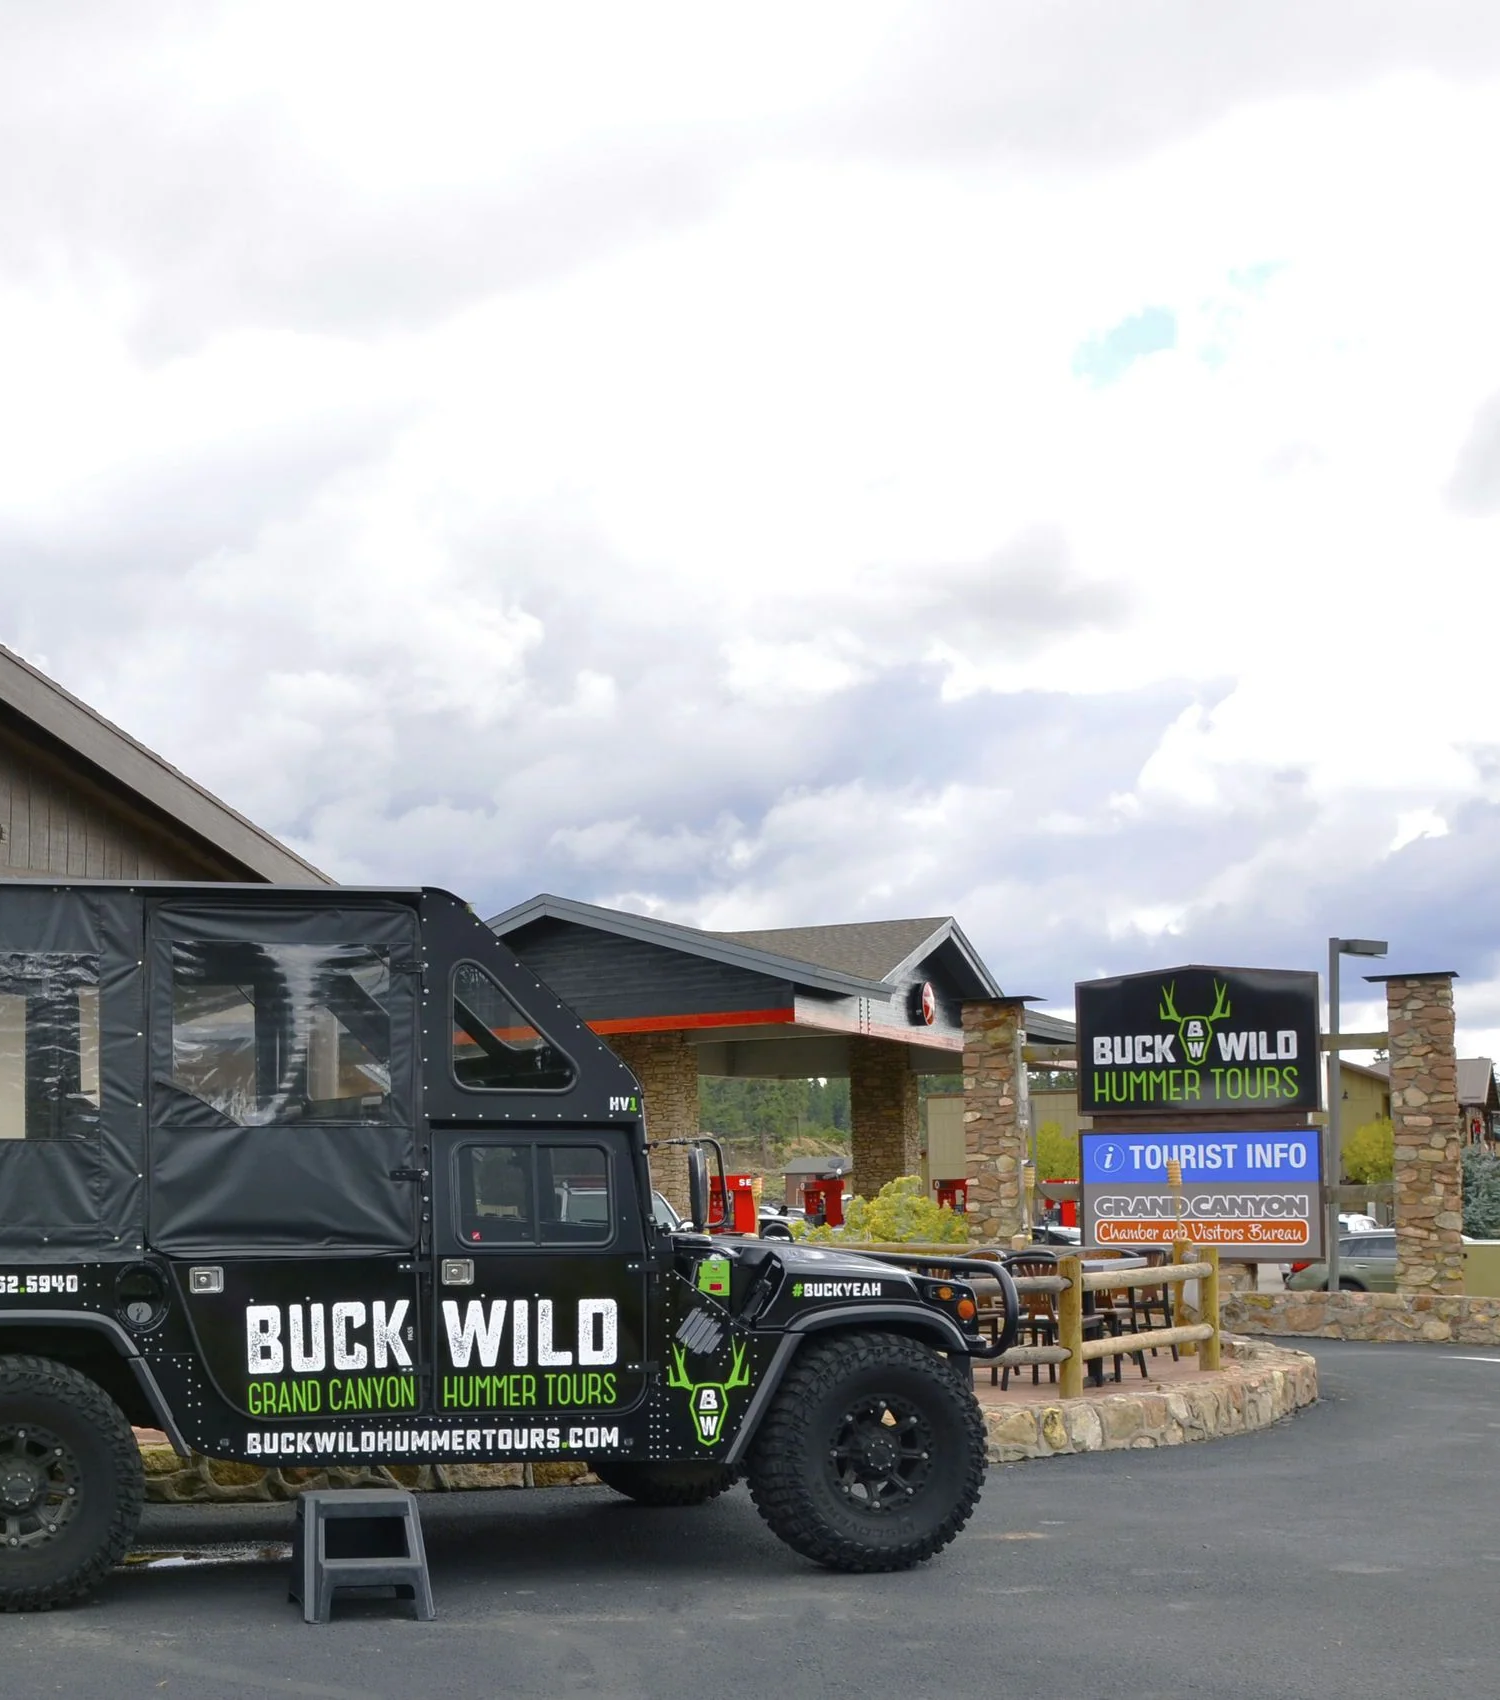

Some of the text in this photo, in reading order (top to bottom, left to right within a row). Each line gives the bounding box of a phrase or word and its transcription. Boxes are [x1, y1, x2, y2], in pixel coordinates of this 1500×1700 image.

[1093, 1030, 1298, 1065] BUCK WILD
[1093, 1066, 1299, 1102] HUMMER TOURS
[609, 1096, 637, 1112] HV1
[1129, 1144, 1237, 1169] TOURIST
[1246, 1143, 1307, 1169] INFO
[1094, 1195, 1309, 1218] GRAND CANYON
[1099, 1222, 1304, 1241] Chamber and Visitors Bureau
[792, 1283, 882, 1298] #BUCKYEAH
[246, 1298, 618, 1374] BUCK WILD
[248, 1372, 617, 1415] GRAND CANYON HUMMER TOURS
[699, 1389, 718, 1410] B
[698, 1416, 718, 1436] W
[246, 1426, 619, 1454] BUCKWILDHUMMERTOURS.COM
